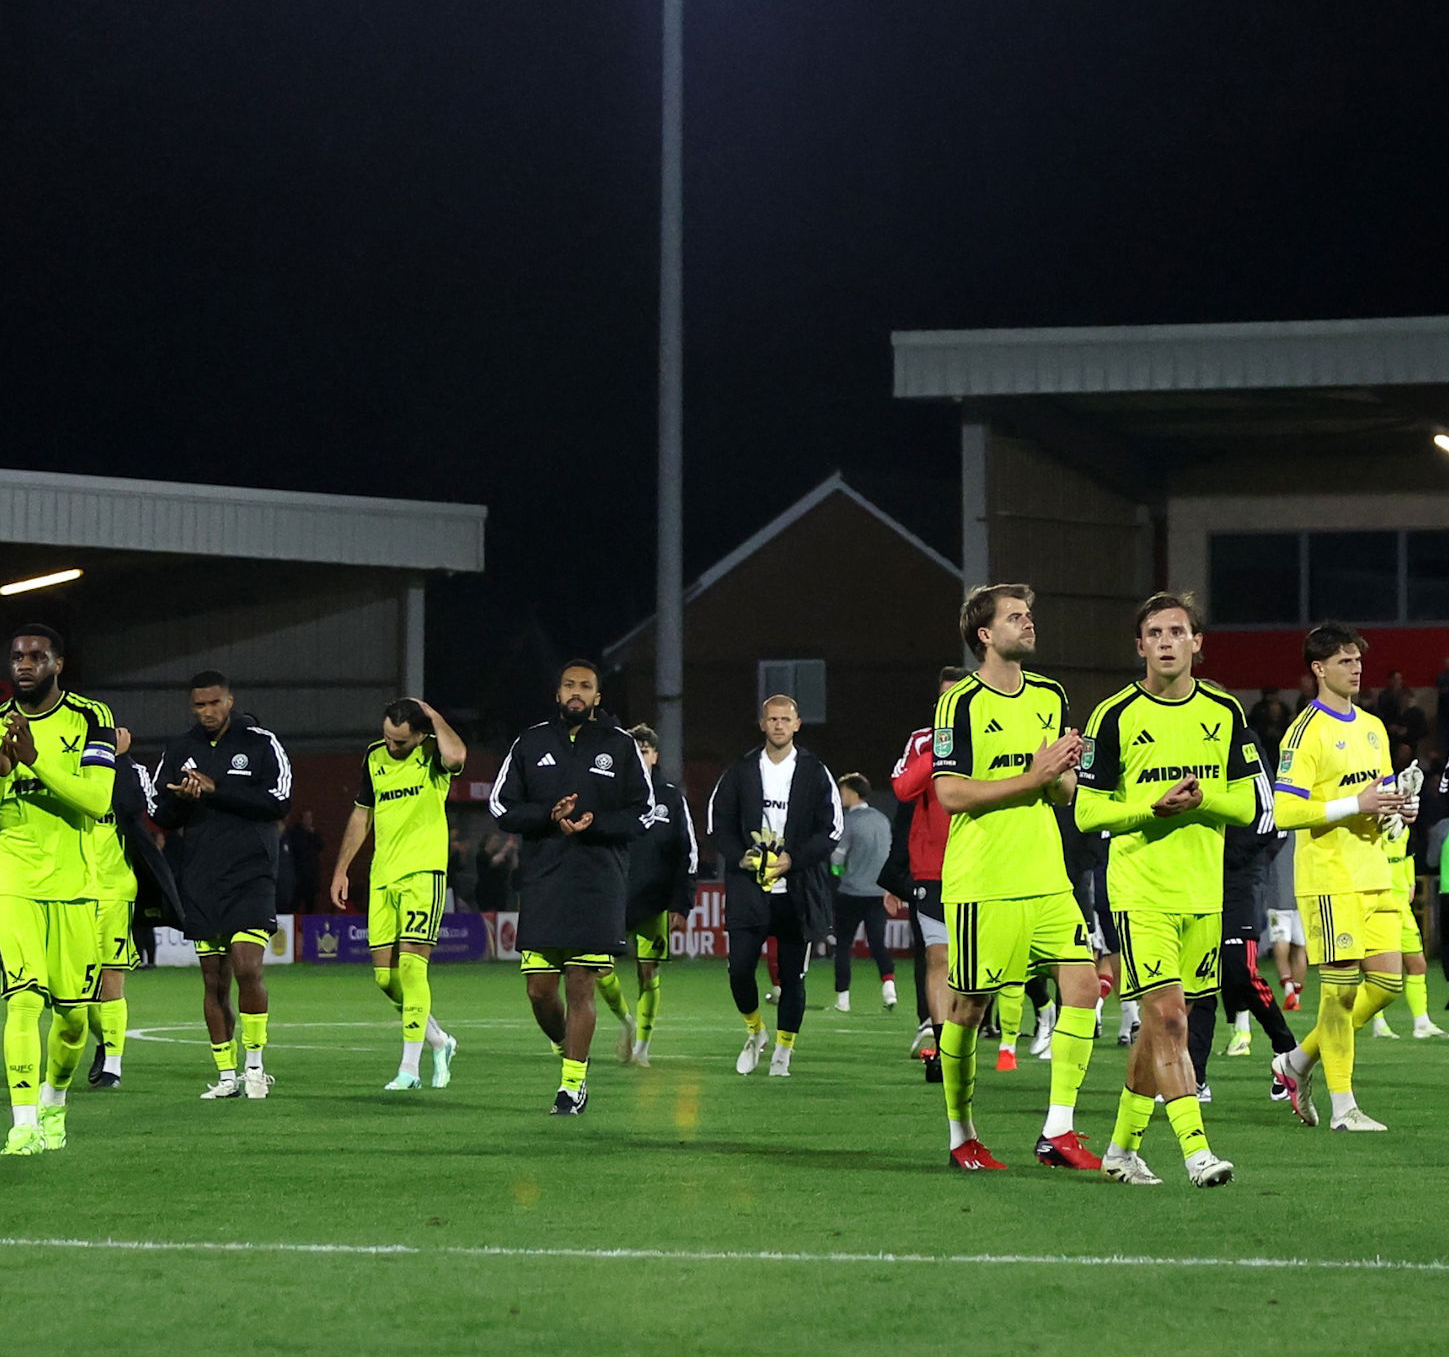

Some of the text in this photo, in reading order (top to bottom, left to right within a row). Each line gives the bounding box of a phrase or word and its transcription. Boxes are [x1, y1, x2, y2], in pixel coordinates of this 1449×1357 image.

[1136, 765, 1220, 784] MIDNITE
[406, 911, 427, 934] 22
[114, 938, 125, 959] 7
[82, 963, 97, 994] 5
